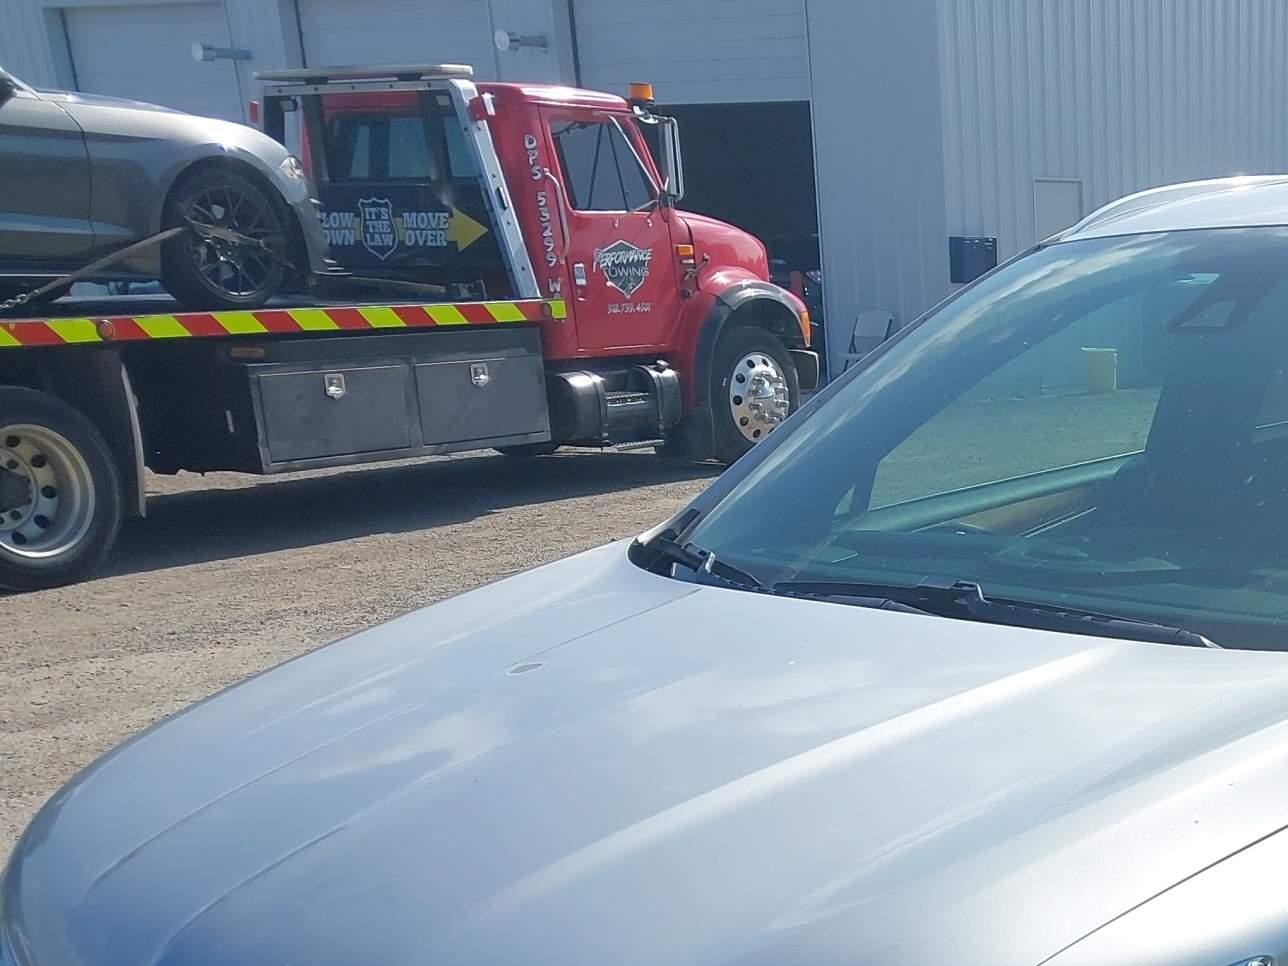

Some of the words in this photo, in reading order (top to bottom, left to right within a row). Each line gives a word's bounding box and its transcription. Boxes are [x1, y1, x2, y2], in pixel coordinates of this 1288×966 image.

[524, 134, 542, 181] DPS
[321, 212, 355, 228] LOW
[364, 206, 390, 220] IT'S
[402, 212, 449, 229] MOVE
[365, 220, 391, 233] THE
[321, 229, 355, 246] OWN
[365, 233, 394, 246] LAW
[404, 229, 448, 247] OVER
